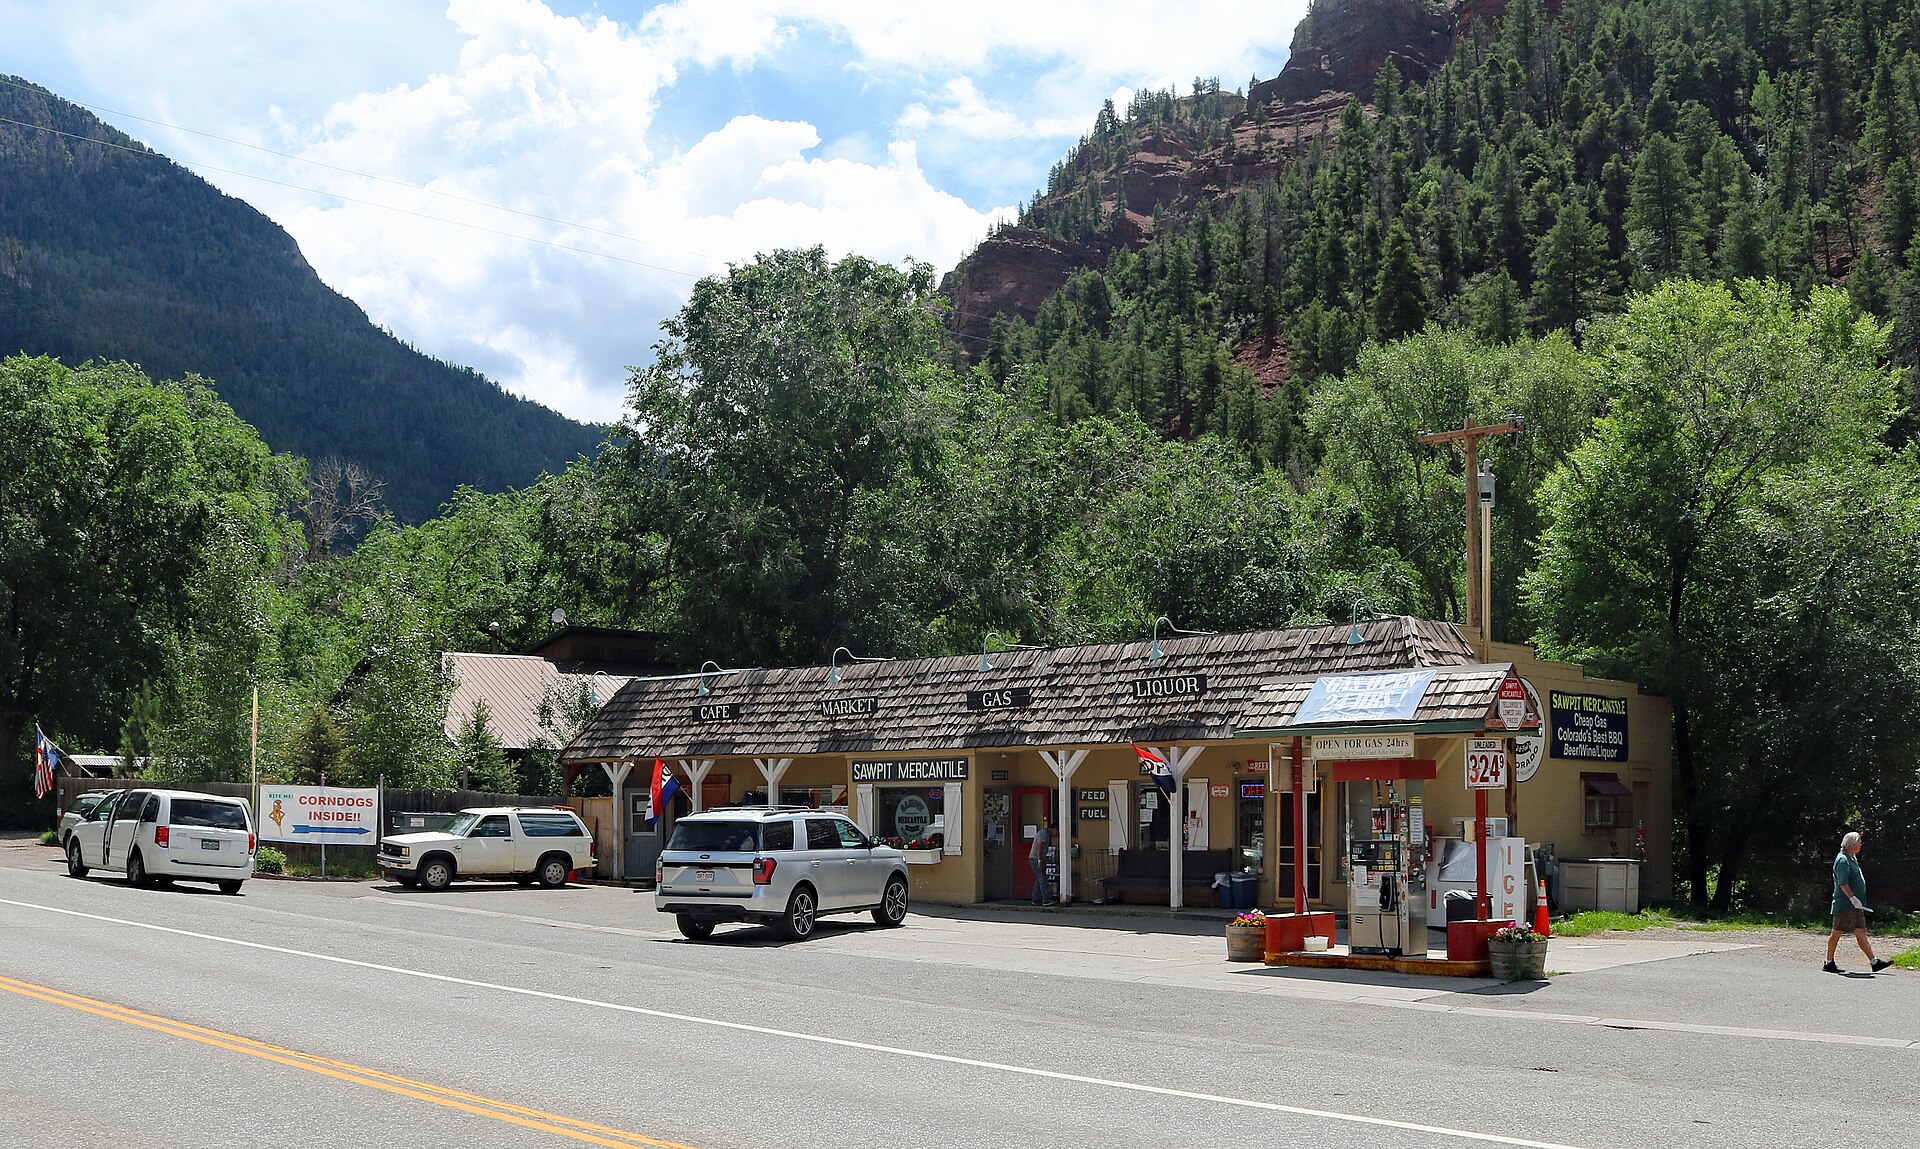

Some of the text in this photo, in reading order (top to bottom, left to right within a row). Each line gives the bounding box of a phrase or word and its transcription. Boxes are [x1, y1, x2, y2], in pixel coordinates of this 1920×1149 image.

[1135, 677, 1200, 697] LIQUOR
[822, 699, 874, 715] MARKET
[982, 691, 1012, 707] GAS
[1552, 693, 1626, 715] SAWPIT MERCANTILE
[700, 705, 730, 719] CAFE
[1574, 712, 1607, 730] Cheap Gas
[1315, 737, 1409, 750] OPEN FOR GAS 24hrs
[1557, 727, 1623, 746] Colorado's Best BBQ
[1474, 741, 1496, 749] UNLEADED
[1563, 743, 1618, 760] Beer/Wine/Liquor
[853, 763, 893, 780] SAWPIT
[298, 795, 374, 808] CORNDOGS
[1081, 791, 1106, 800] FEED
[308, 811, 361, 822] INSIDE!!
[1081, 809, 1106, 818] FUEL
